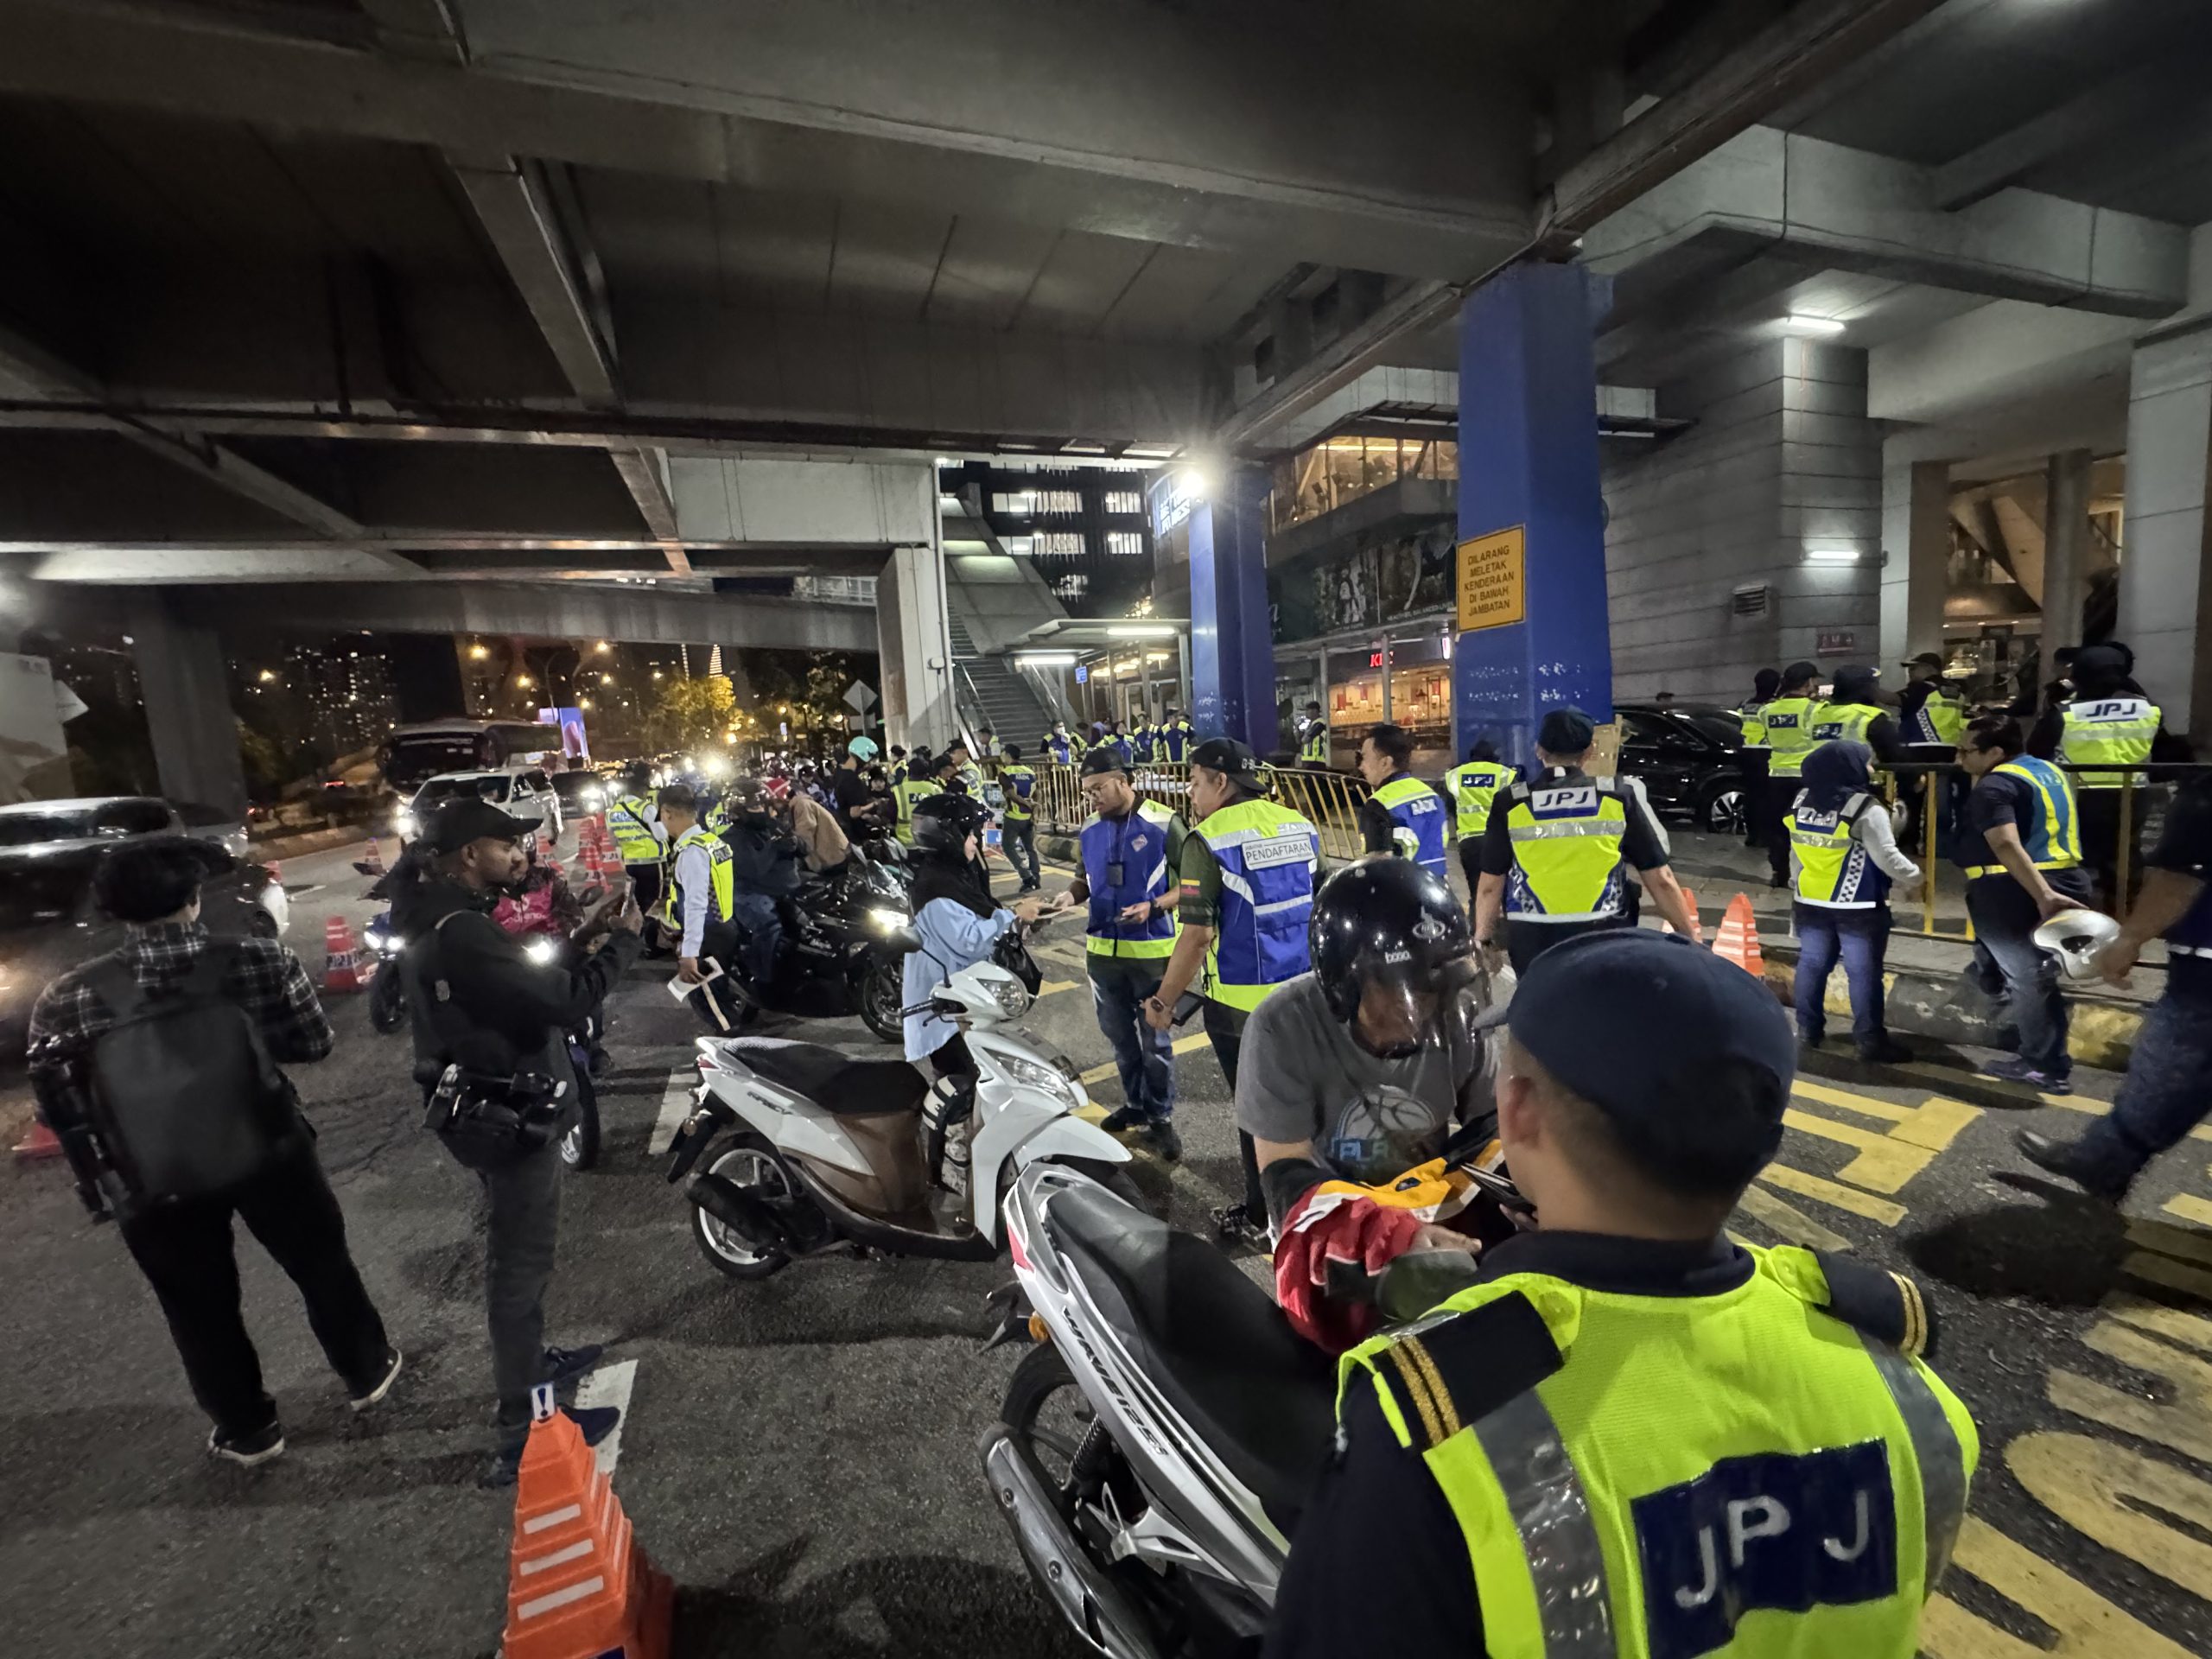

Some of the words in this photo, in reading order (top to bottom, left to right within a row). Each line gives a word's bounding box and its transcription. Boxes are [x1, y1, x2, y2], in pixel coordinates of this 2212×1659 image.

[1467, 544, 1510, 565] DILARANG
[1470, 559, 1507, 578] MELETAK
[1464, 570, 1515, 592] KENDERAAN
[1469, 593, 1477, 603] DI
[1479, 585, 1509, 601] BAWAH
[1468, 598, 1510, 616] JAMBATAN
[2087, 702, 2137, 717] JPJ
[1770, 716, 1796, 726] JPJ
[1463, 775, 1492, 785] JPJ
[1539, 790, 1589, 807] JPJ
[1245, 842, 1312, 861] PENDAFTARAN
[1674, 1490, 1869, 1609] JPJ
